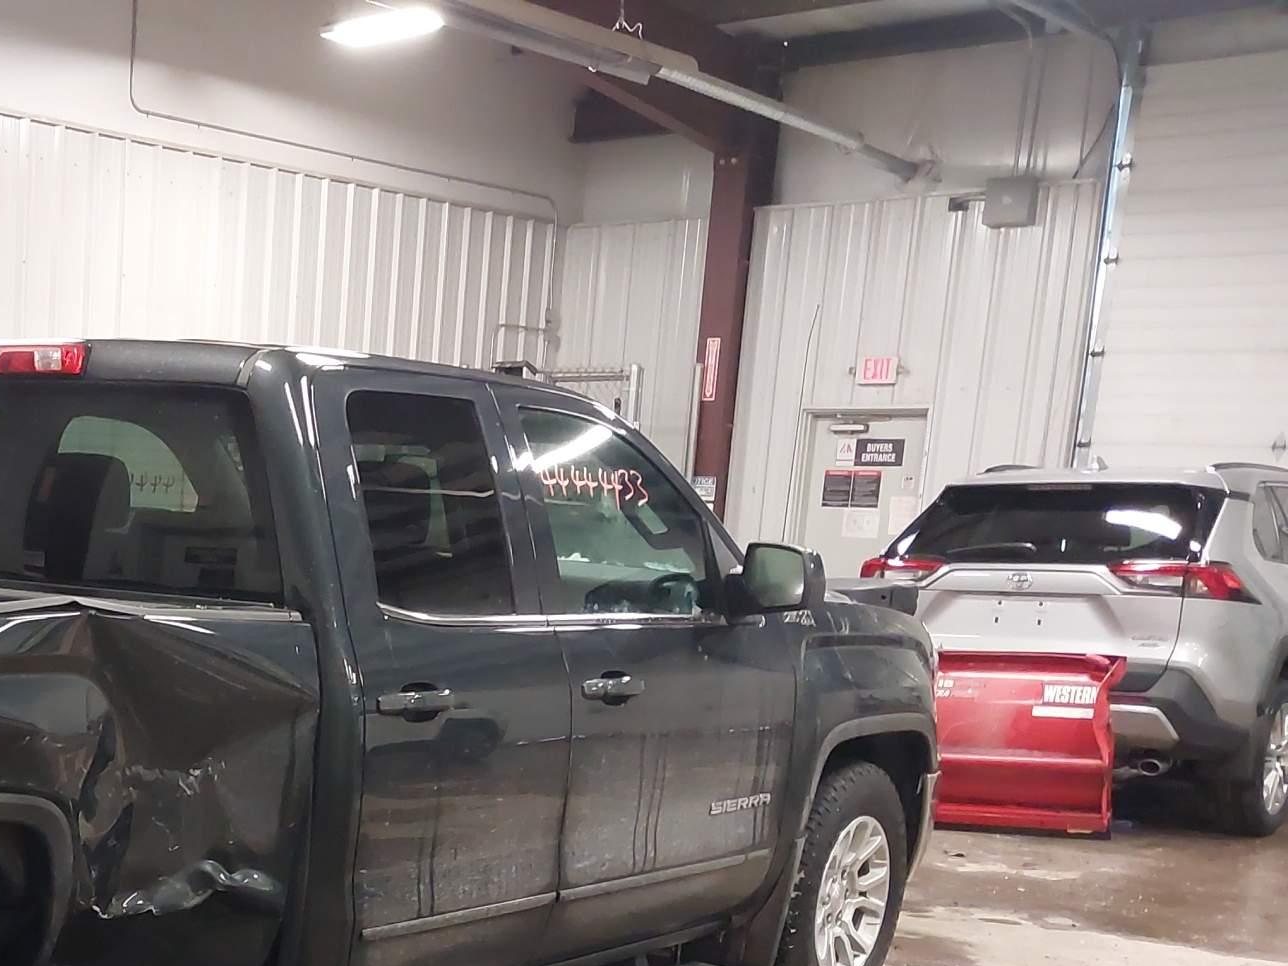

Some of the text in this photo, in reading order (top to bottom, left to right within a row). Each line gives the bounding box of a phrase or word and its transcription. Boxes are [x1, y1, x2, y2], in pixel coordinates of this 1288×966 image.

[863, 357, 892, 380] EXIT
[861, 453, 896, 462] ENTRANCE
[866, 443, 893, 452] BUYERS
[541, 463, 649, 511] 44444433
[1043, 685, 1097, 704] WESTERN
[710, 793, 771, 815] SIERRA
